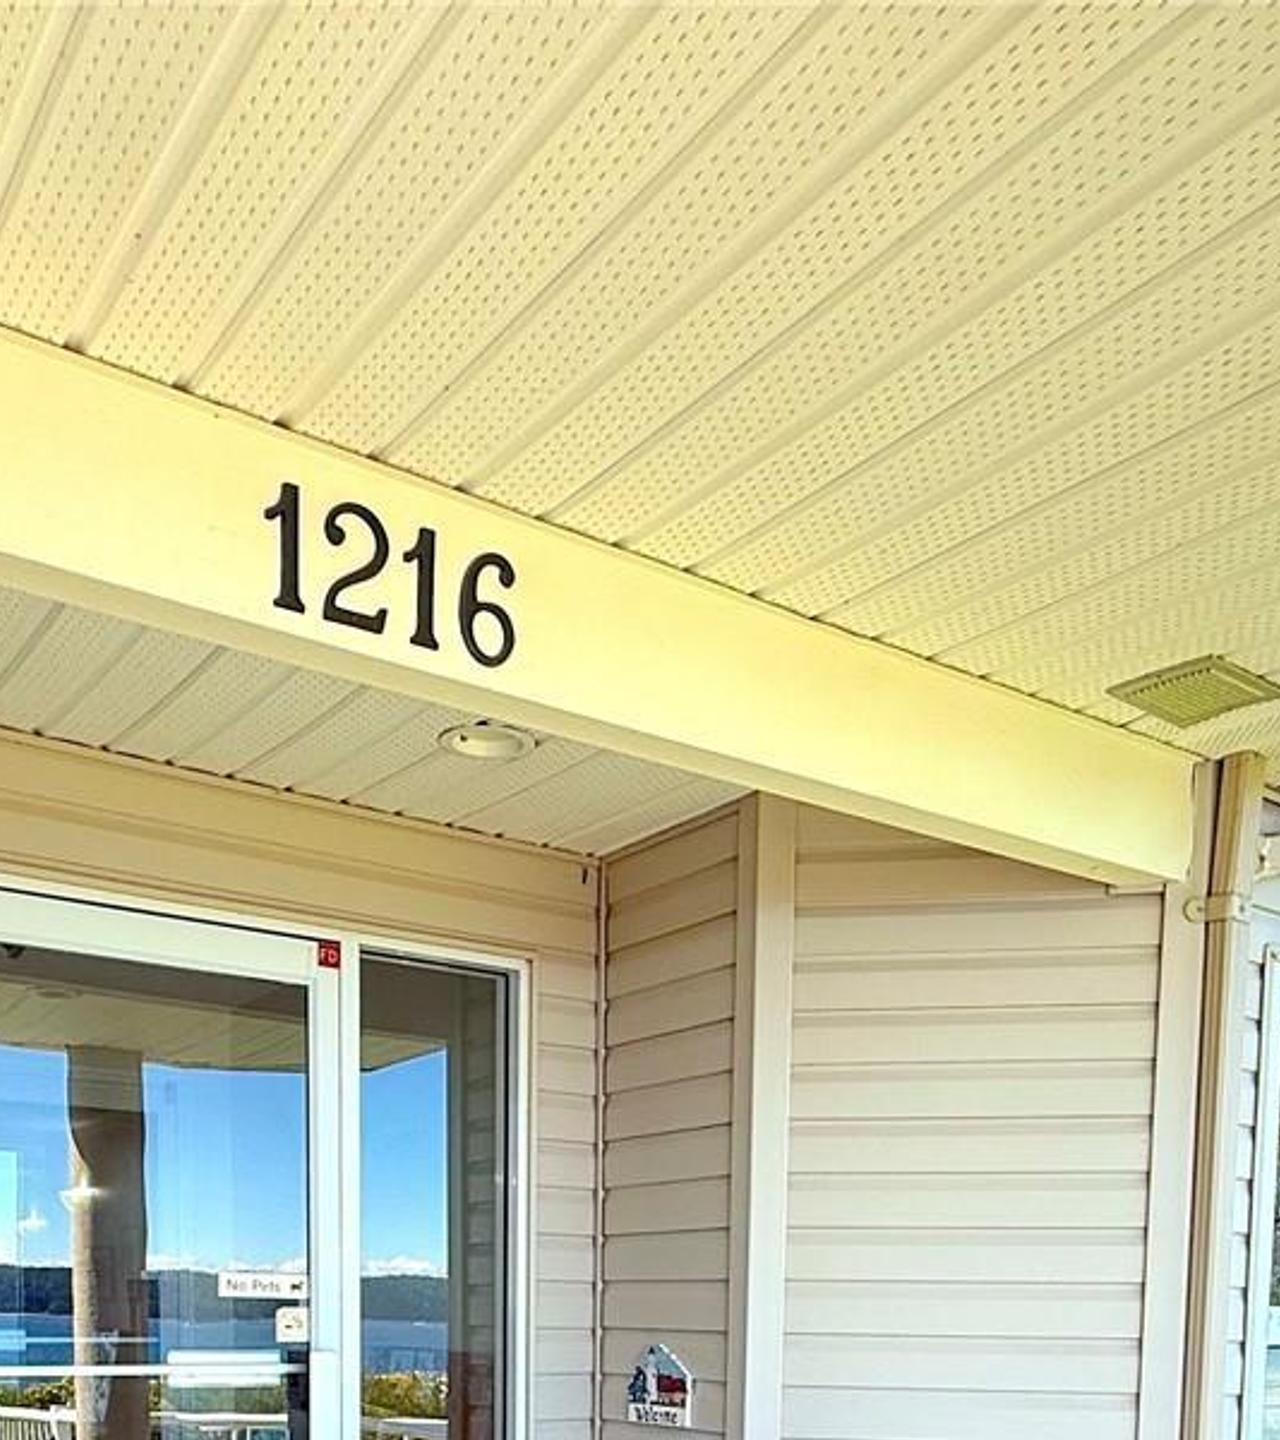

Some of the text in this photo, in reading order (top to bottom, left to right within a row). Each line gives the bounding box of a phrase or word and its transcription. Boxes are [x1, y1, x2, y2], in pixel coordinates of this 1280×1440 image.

[263, 482, 516, 668] 1216
[226, 1278, 281, 1293] No Pets
